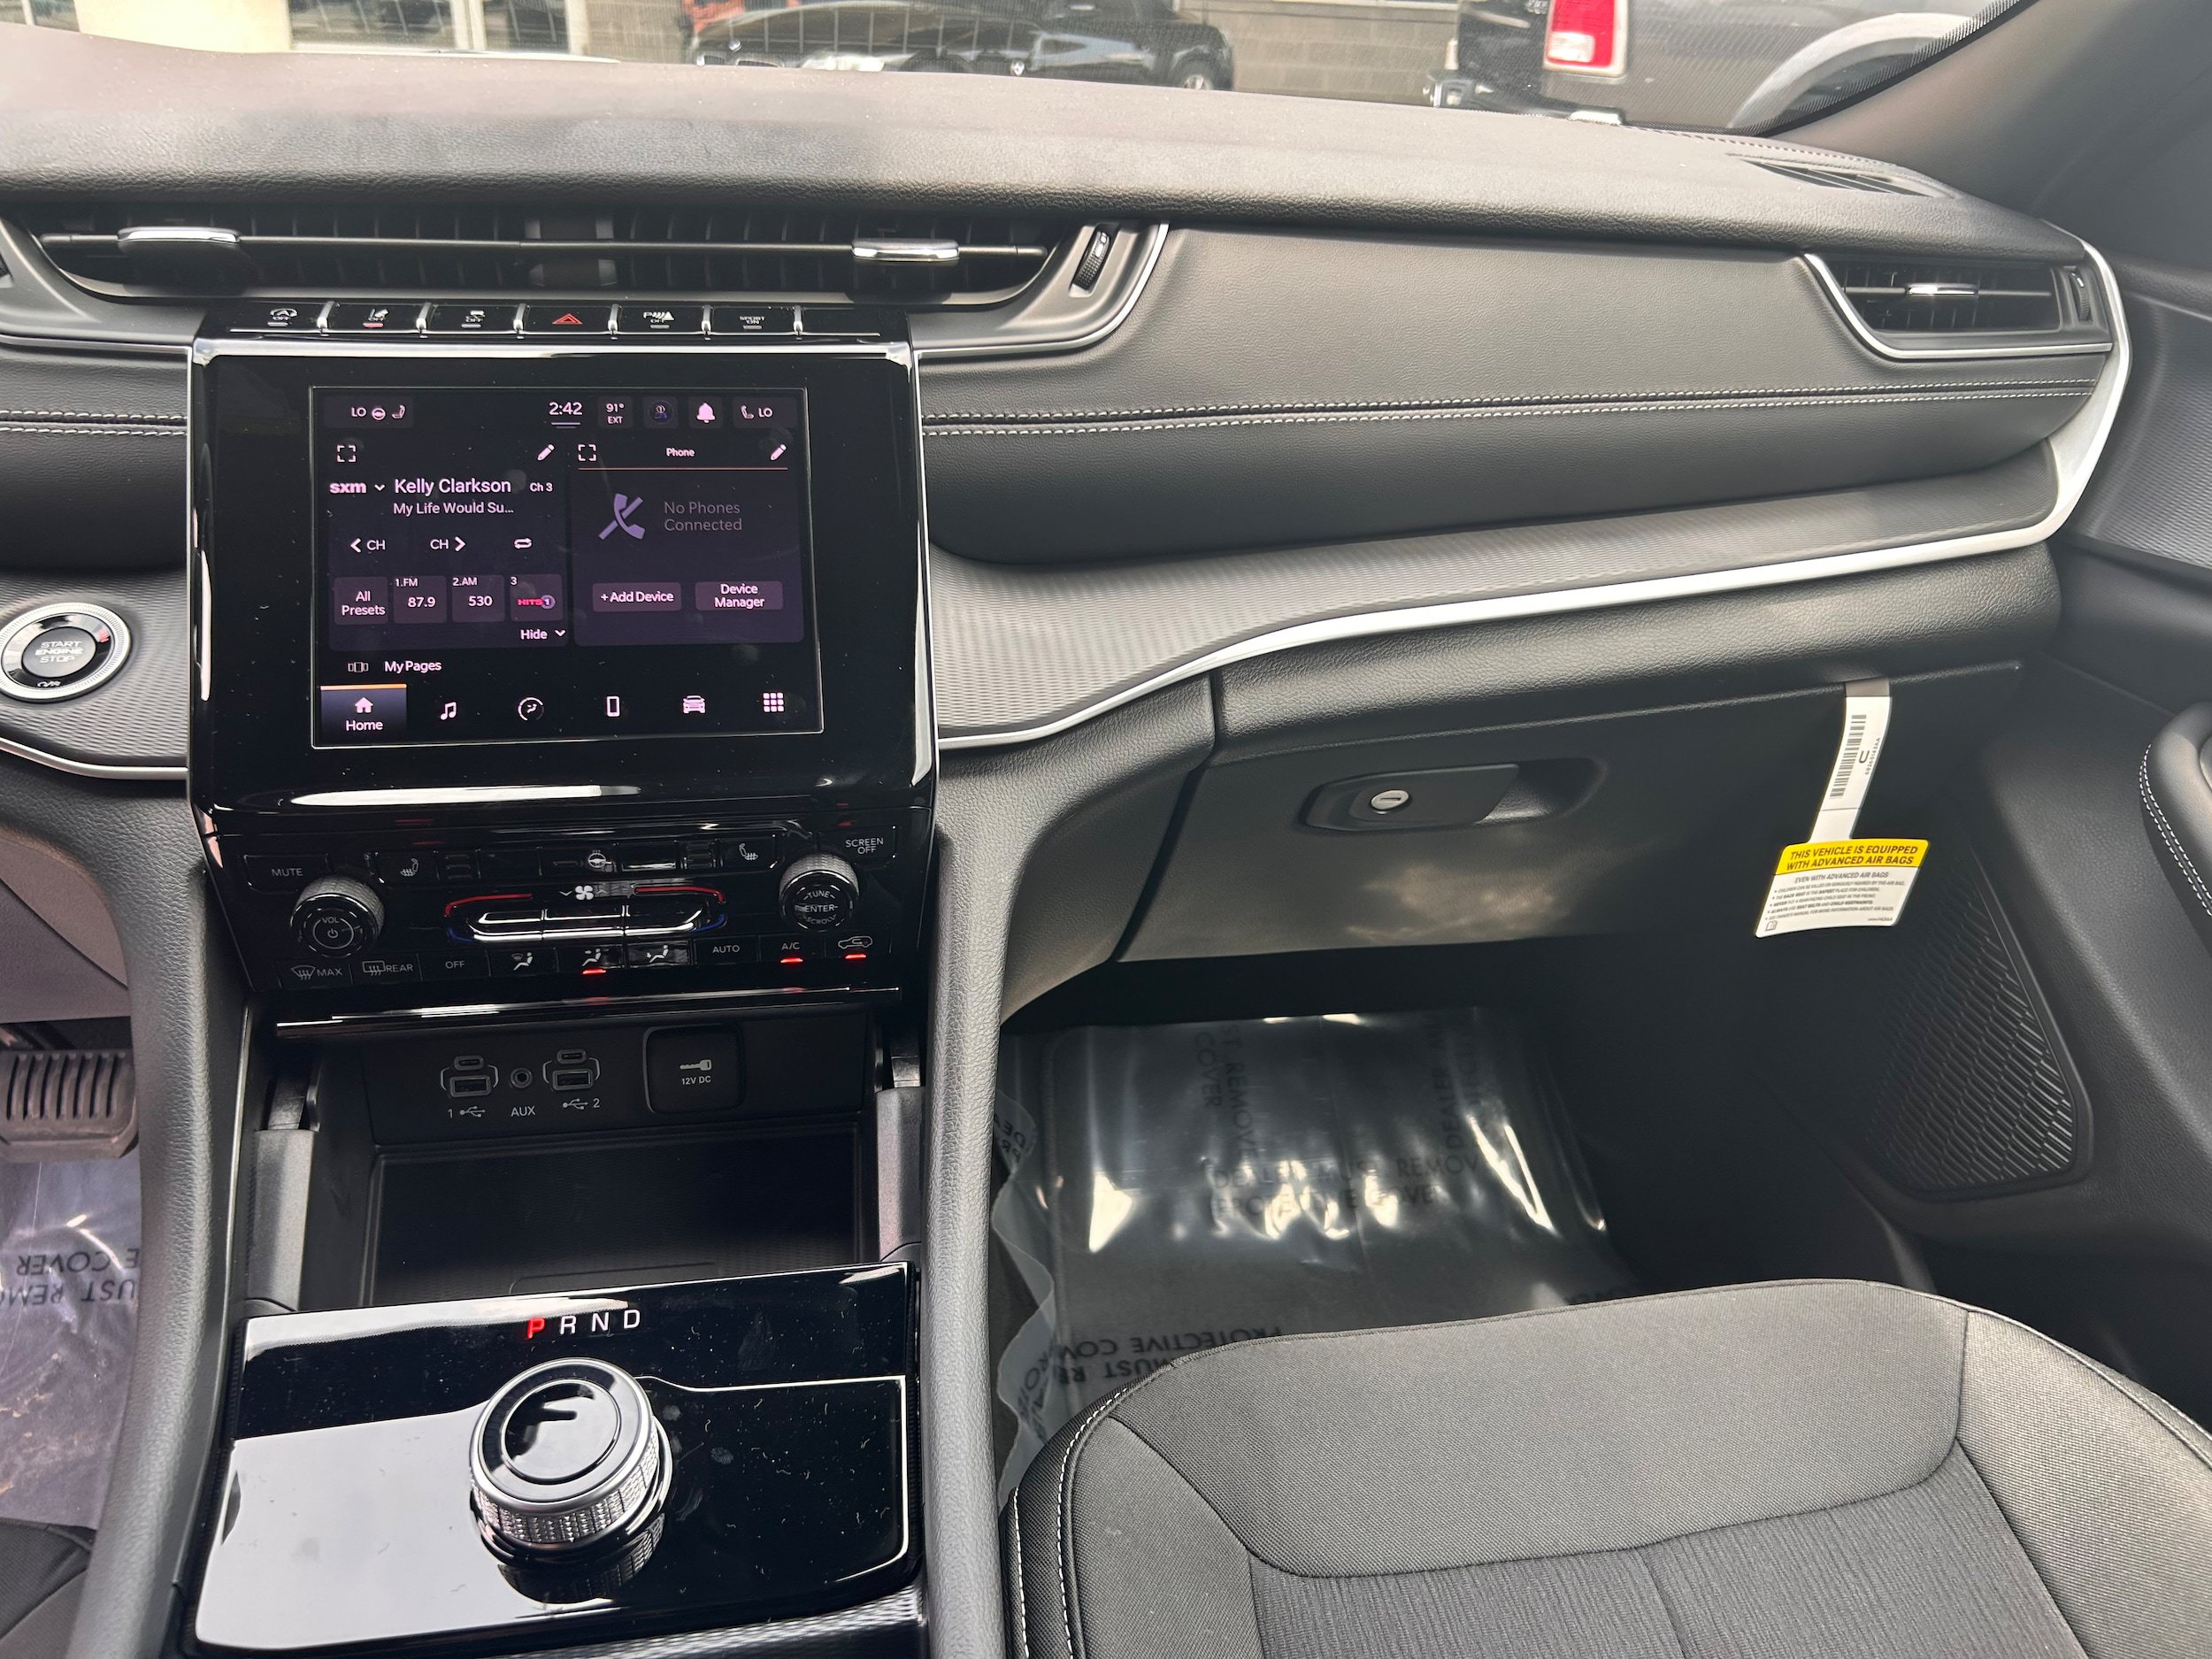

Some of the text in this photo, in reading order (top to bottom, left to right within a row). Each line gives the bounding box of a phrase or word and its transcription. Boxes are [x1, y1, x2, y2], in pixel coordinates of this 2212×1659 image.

[351, 407, 366, 417] LO
[549, 402, 582, 415] 2:42
[606, 403, 625, 412] 91°
[758, 408, 772, 418] LO
[665, 448, 695, 457] Phone
[329, 482, 366, 494] sxm
[395, 478, 511, 496] Kelly Clarkson
[529, 482, 553, 492] Ch 3
[393, 502, 514, 517] My Life Would Su...
[664, 501, 741, 514] No Phones
[664, 518, 742, 531] Connected
[366, 540, 386, 551] CH
[430, 539, 449, 550] CH
[395, 578, 419, 588] 1.FM
[452, 577, 478, 587] 2.AM
[510, 576, 518, 586] 3
[720, 583, 759, 595] Device
[356, 590, 371, 603] All
[468, 596, 493, 607] 530
[636, 591, 674, 603] Device
[407, 597, 436, 608] 87.9
[714, 595, 765, 610] Manager
[342, 604, 386, 617] Presets
[520, 629, 548, 640] Hide
[384, 659, 442, 675] My Pages
[345, 720, 383, 732] Home
[1859, 750, 1870, 764] U
[845, 837, 884, 848] SCREEN
[856, 846, 876, 855] OFF
[1790, 845, 1918, 860] THIS VEHICLE IS EQUIPPED
[1786, 856, 1914, 872] WITH ADVANCED AIR BAGS
[271, 868, 303, 878] MUTE
[807, 889, 830, 899] TUNE
[712, 945, 740, 954] AUTO
[781, 941, 800, 951] A/C
[386, 964, 413, 973] REAR
[445, 960, 465, 969] OFF
[317, 968, 342, 978] MAX
[681, 1075, 711, 1086] 12V DC
[592, 1098, 601, 1110] 2
[447, 1108, 454, 1118] 1
[511, 1106, 536, 1118] AUX
[17, 1250, 111, 1275] COVER
[526, 1309, 641, 1340] P R N D
